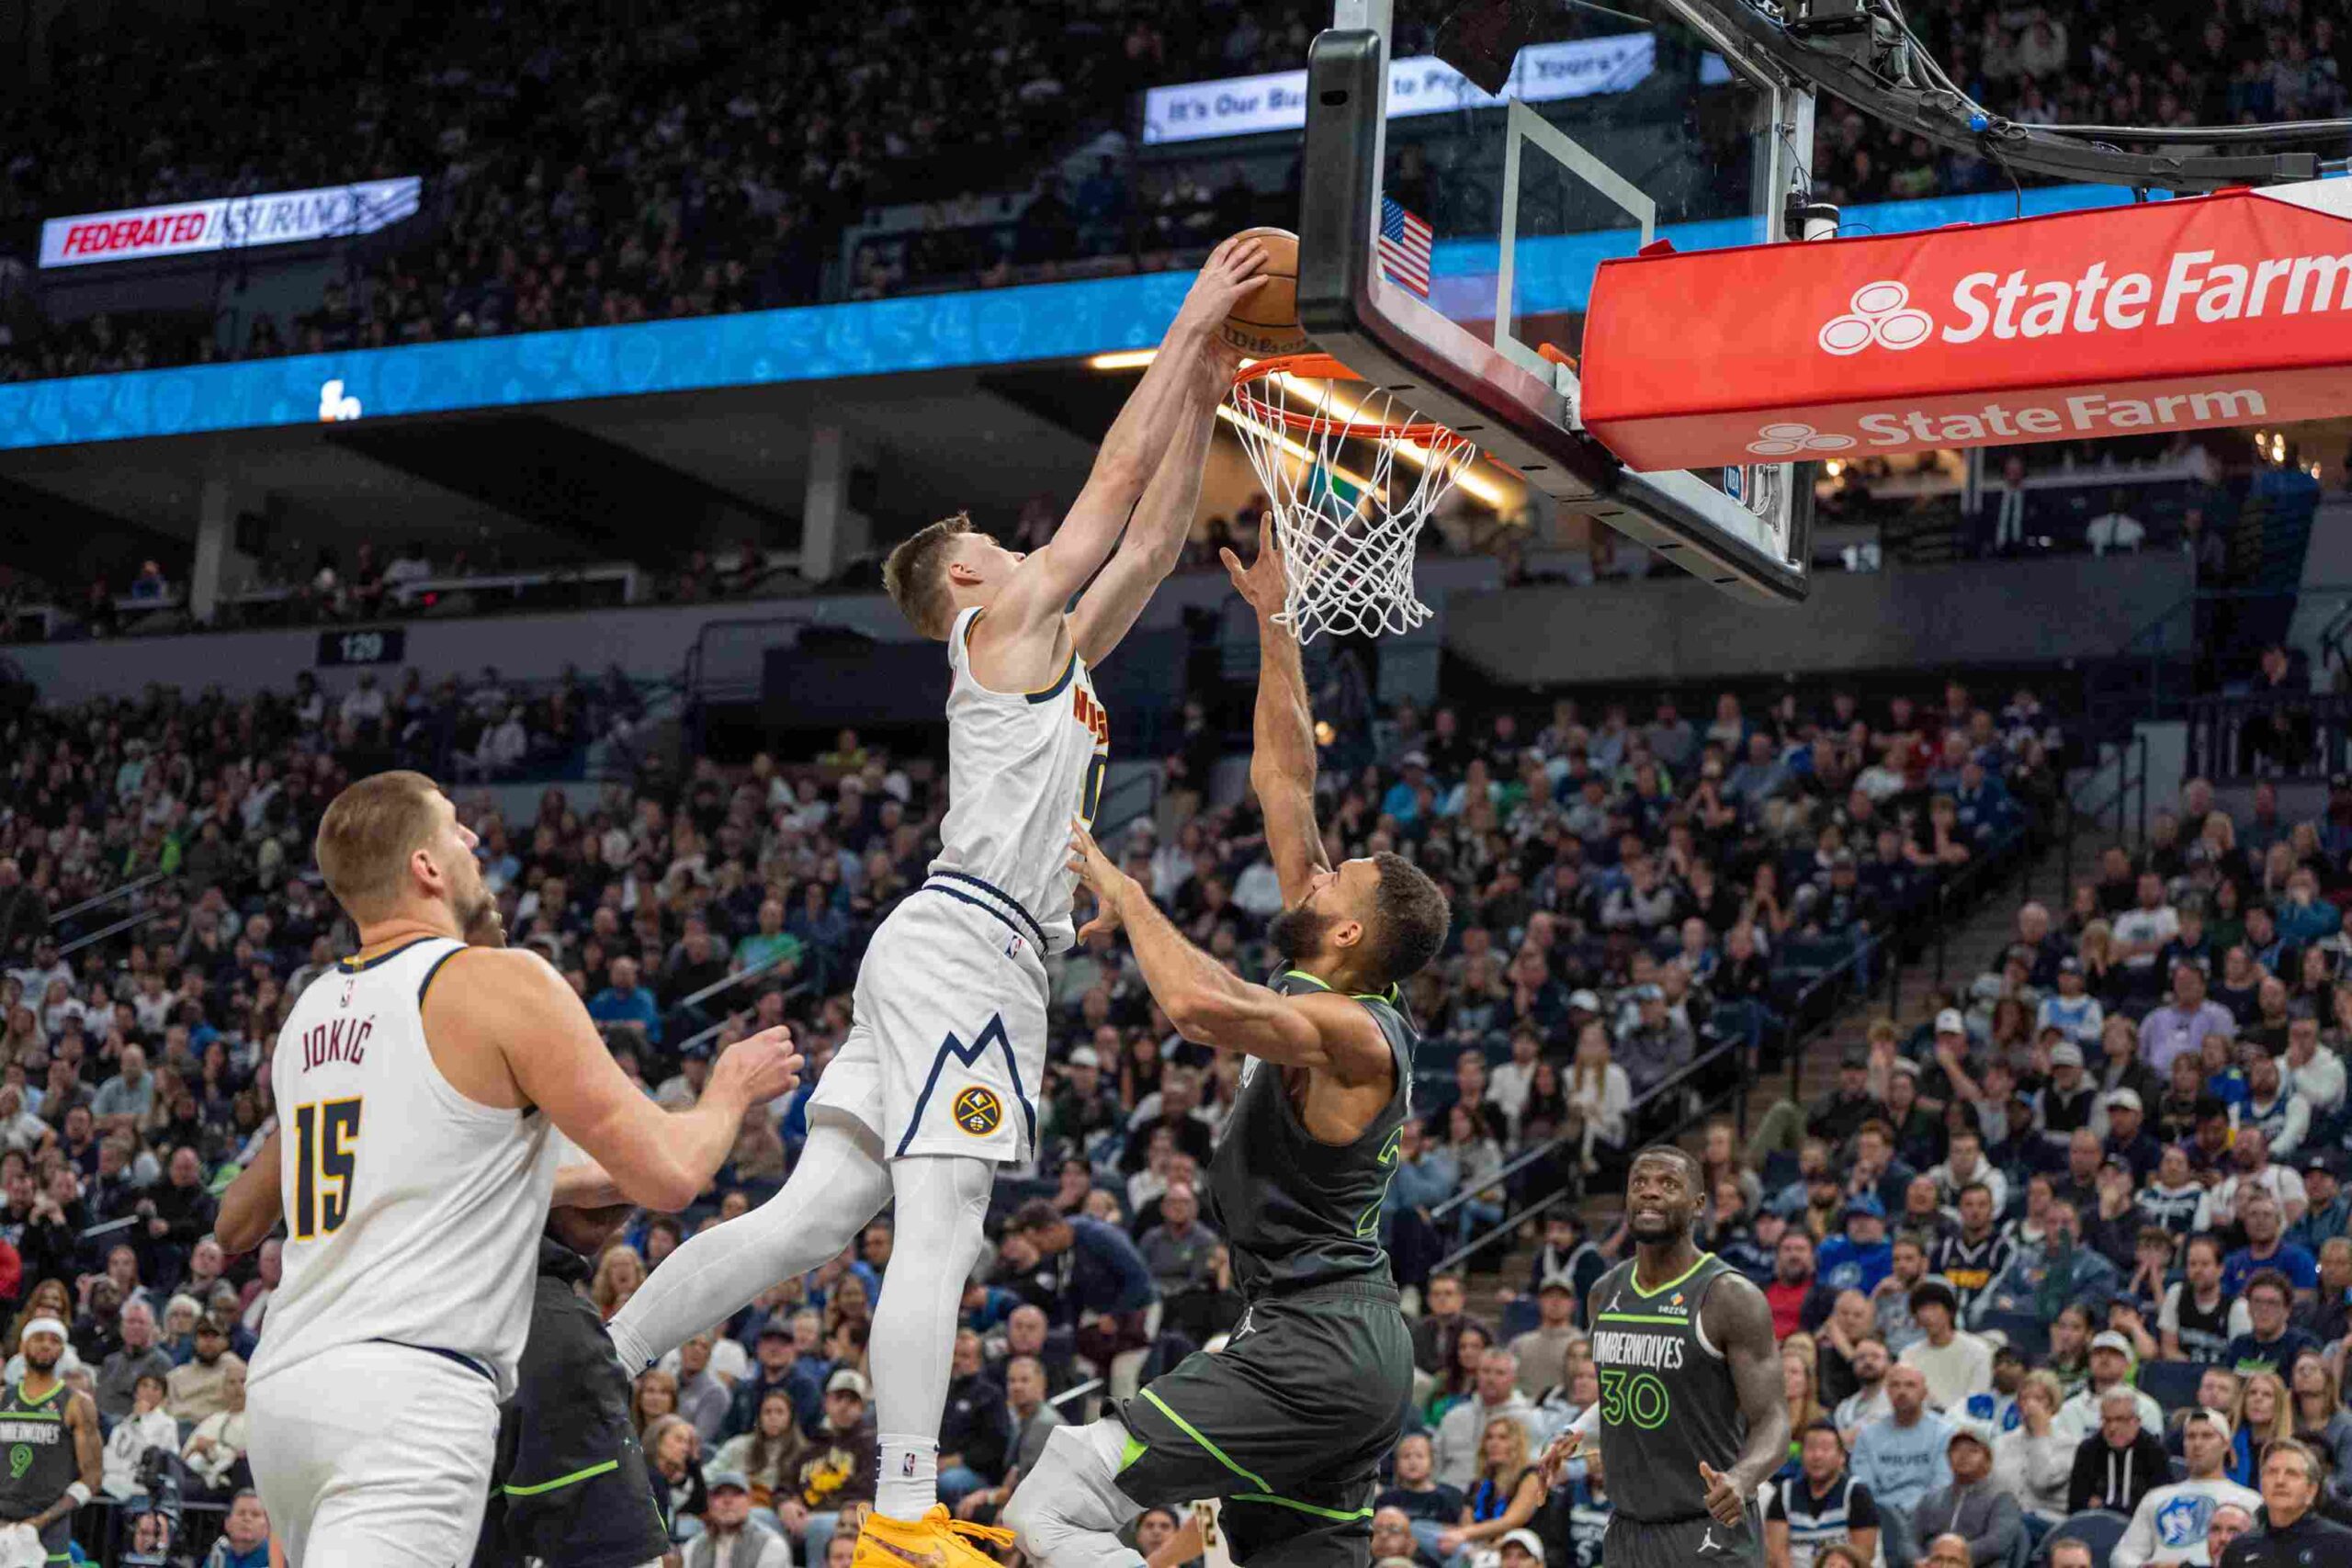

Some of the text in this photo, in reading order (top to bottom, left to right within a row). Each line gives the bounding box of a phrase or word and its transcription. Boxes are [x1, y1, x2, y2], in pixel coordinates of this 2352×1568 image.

[1216, 94, 1260, 116] Our
[62, 214, 207, 257] FEDERATED
[302, 1014, 375, 1073] JOKIĆ
[295, 1095, 363, 1242] 15
[1657, 1304, 1688, 1316] sezzle
[1592, 1331, 1685, 1372] TIMBERWOLVES
[1600, 1370, 1669, 1429] 30
[9, 1442, 33, 1478] 9
